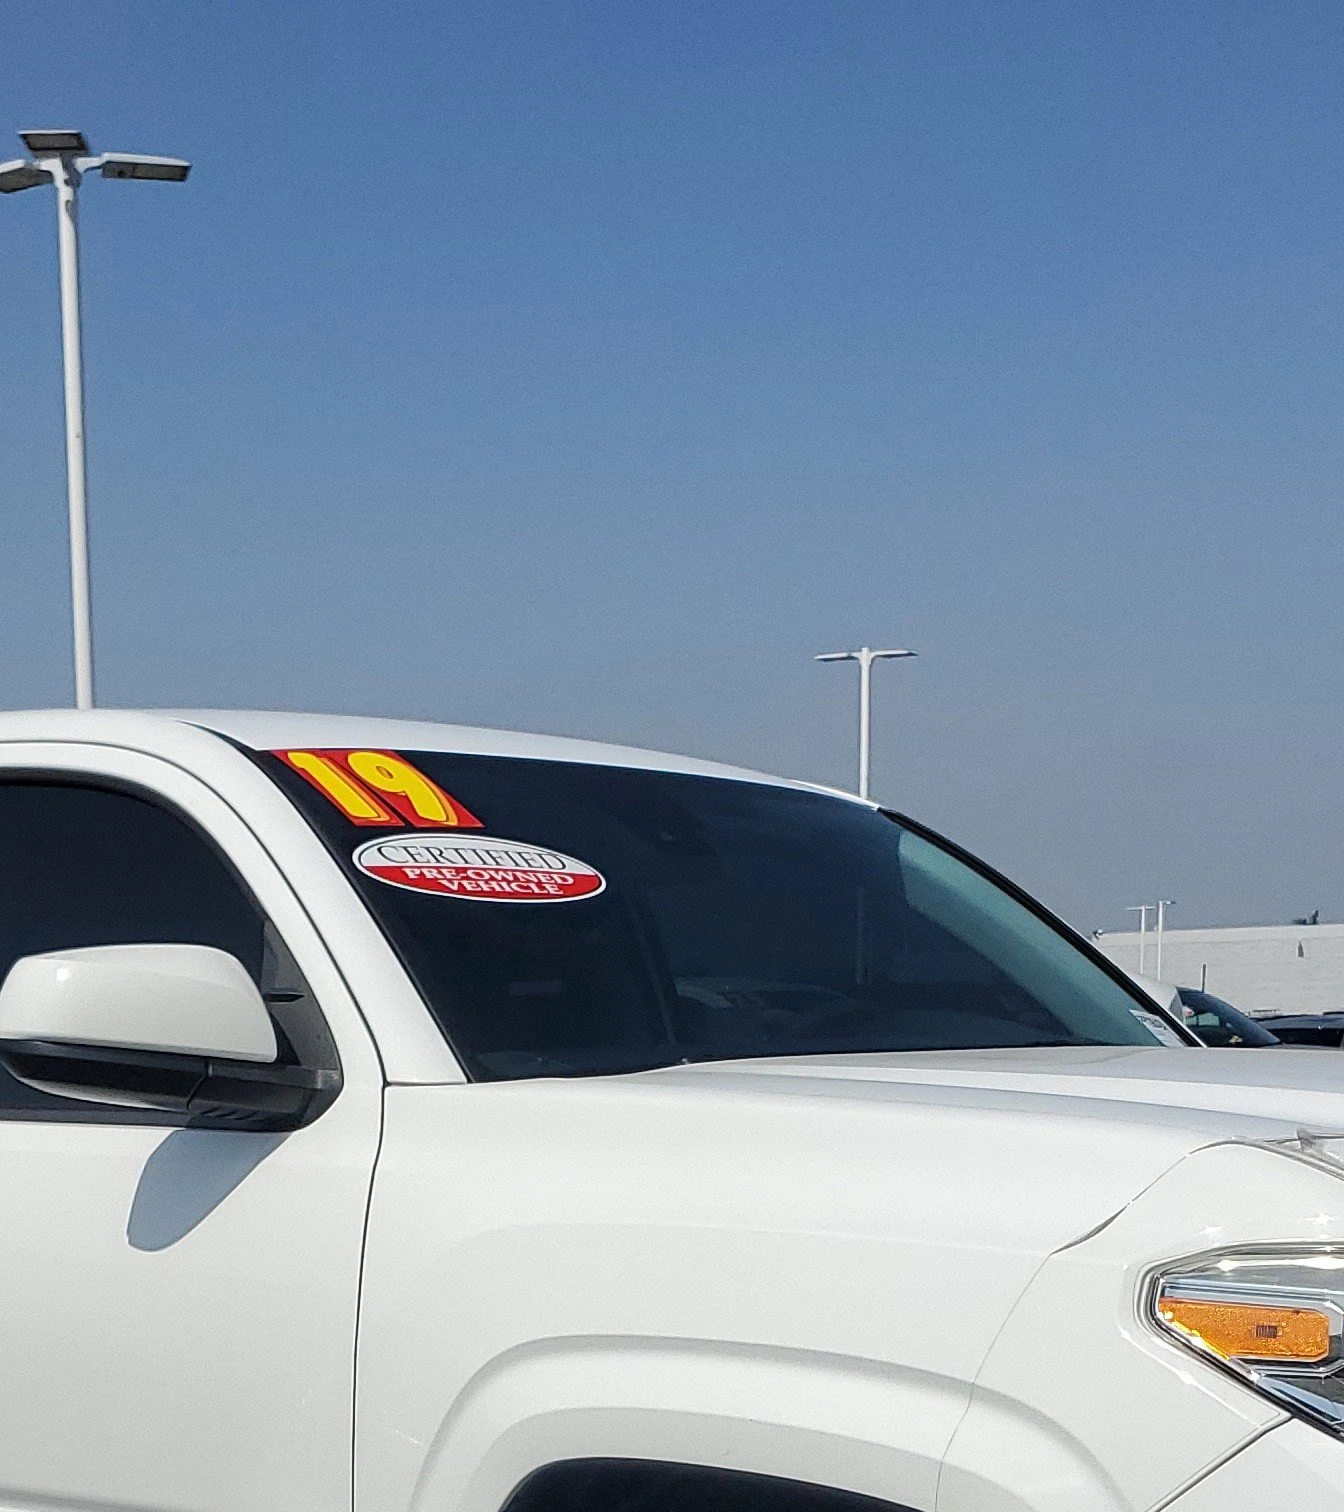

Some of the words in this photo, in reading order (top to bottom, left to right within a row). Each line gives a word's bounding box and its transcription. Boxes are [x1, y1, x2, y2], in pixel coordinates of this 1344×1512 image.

[287, 750, 459, 826] 19
[376, 845, 567, 870] CERTIFIED
[401, 867, 575, 885] PRE-OWNED
[436, 879, 565, 895] VEHICLE
